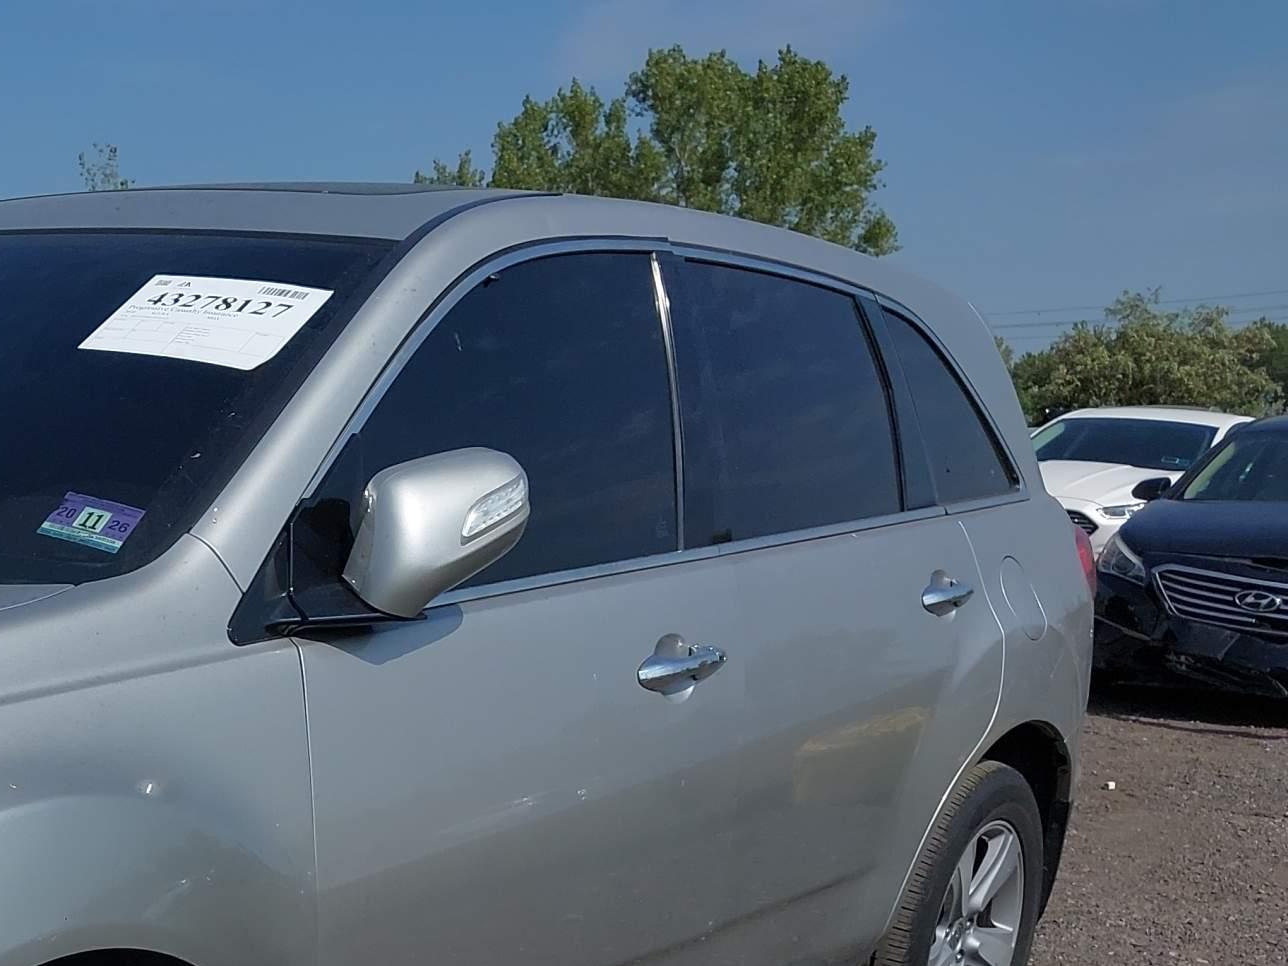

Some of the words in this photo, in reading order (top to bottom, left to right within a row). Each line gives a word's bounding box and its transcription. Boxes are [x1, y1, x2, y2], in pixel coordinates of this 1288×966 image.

[147, 291, 295, 318] 43278127
[57, 507, 77, 518] 20
[79, 512, 104, 530] 11
[108, 520, 130, 533] 26
